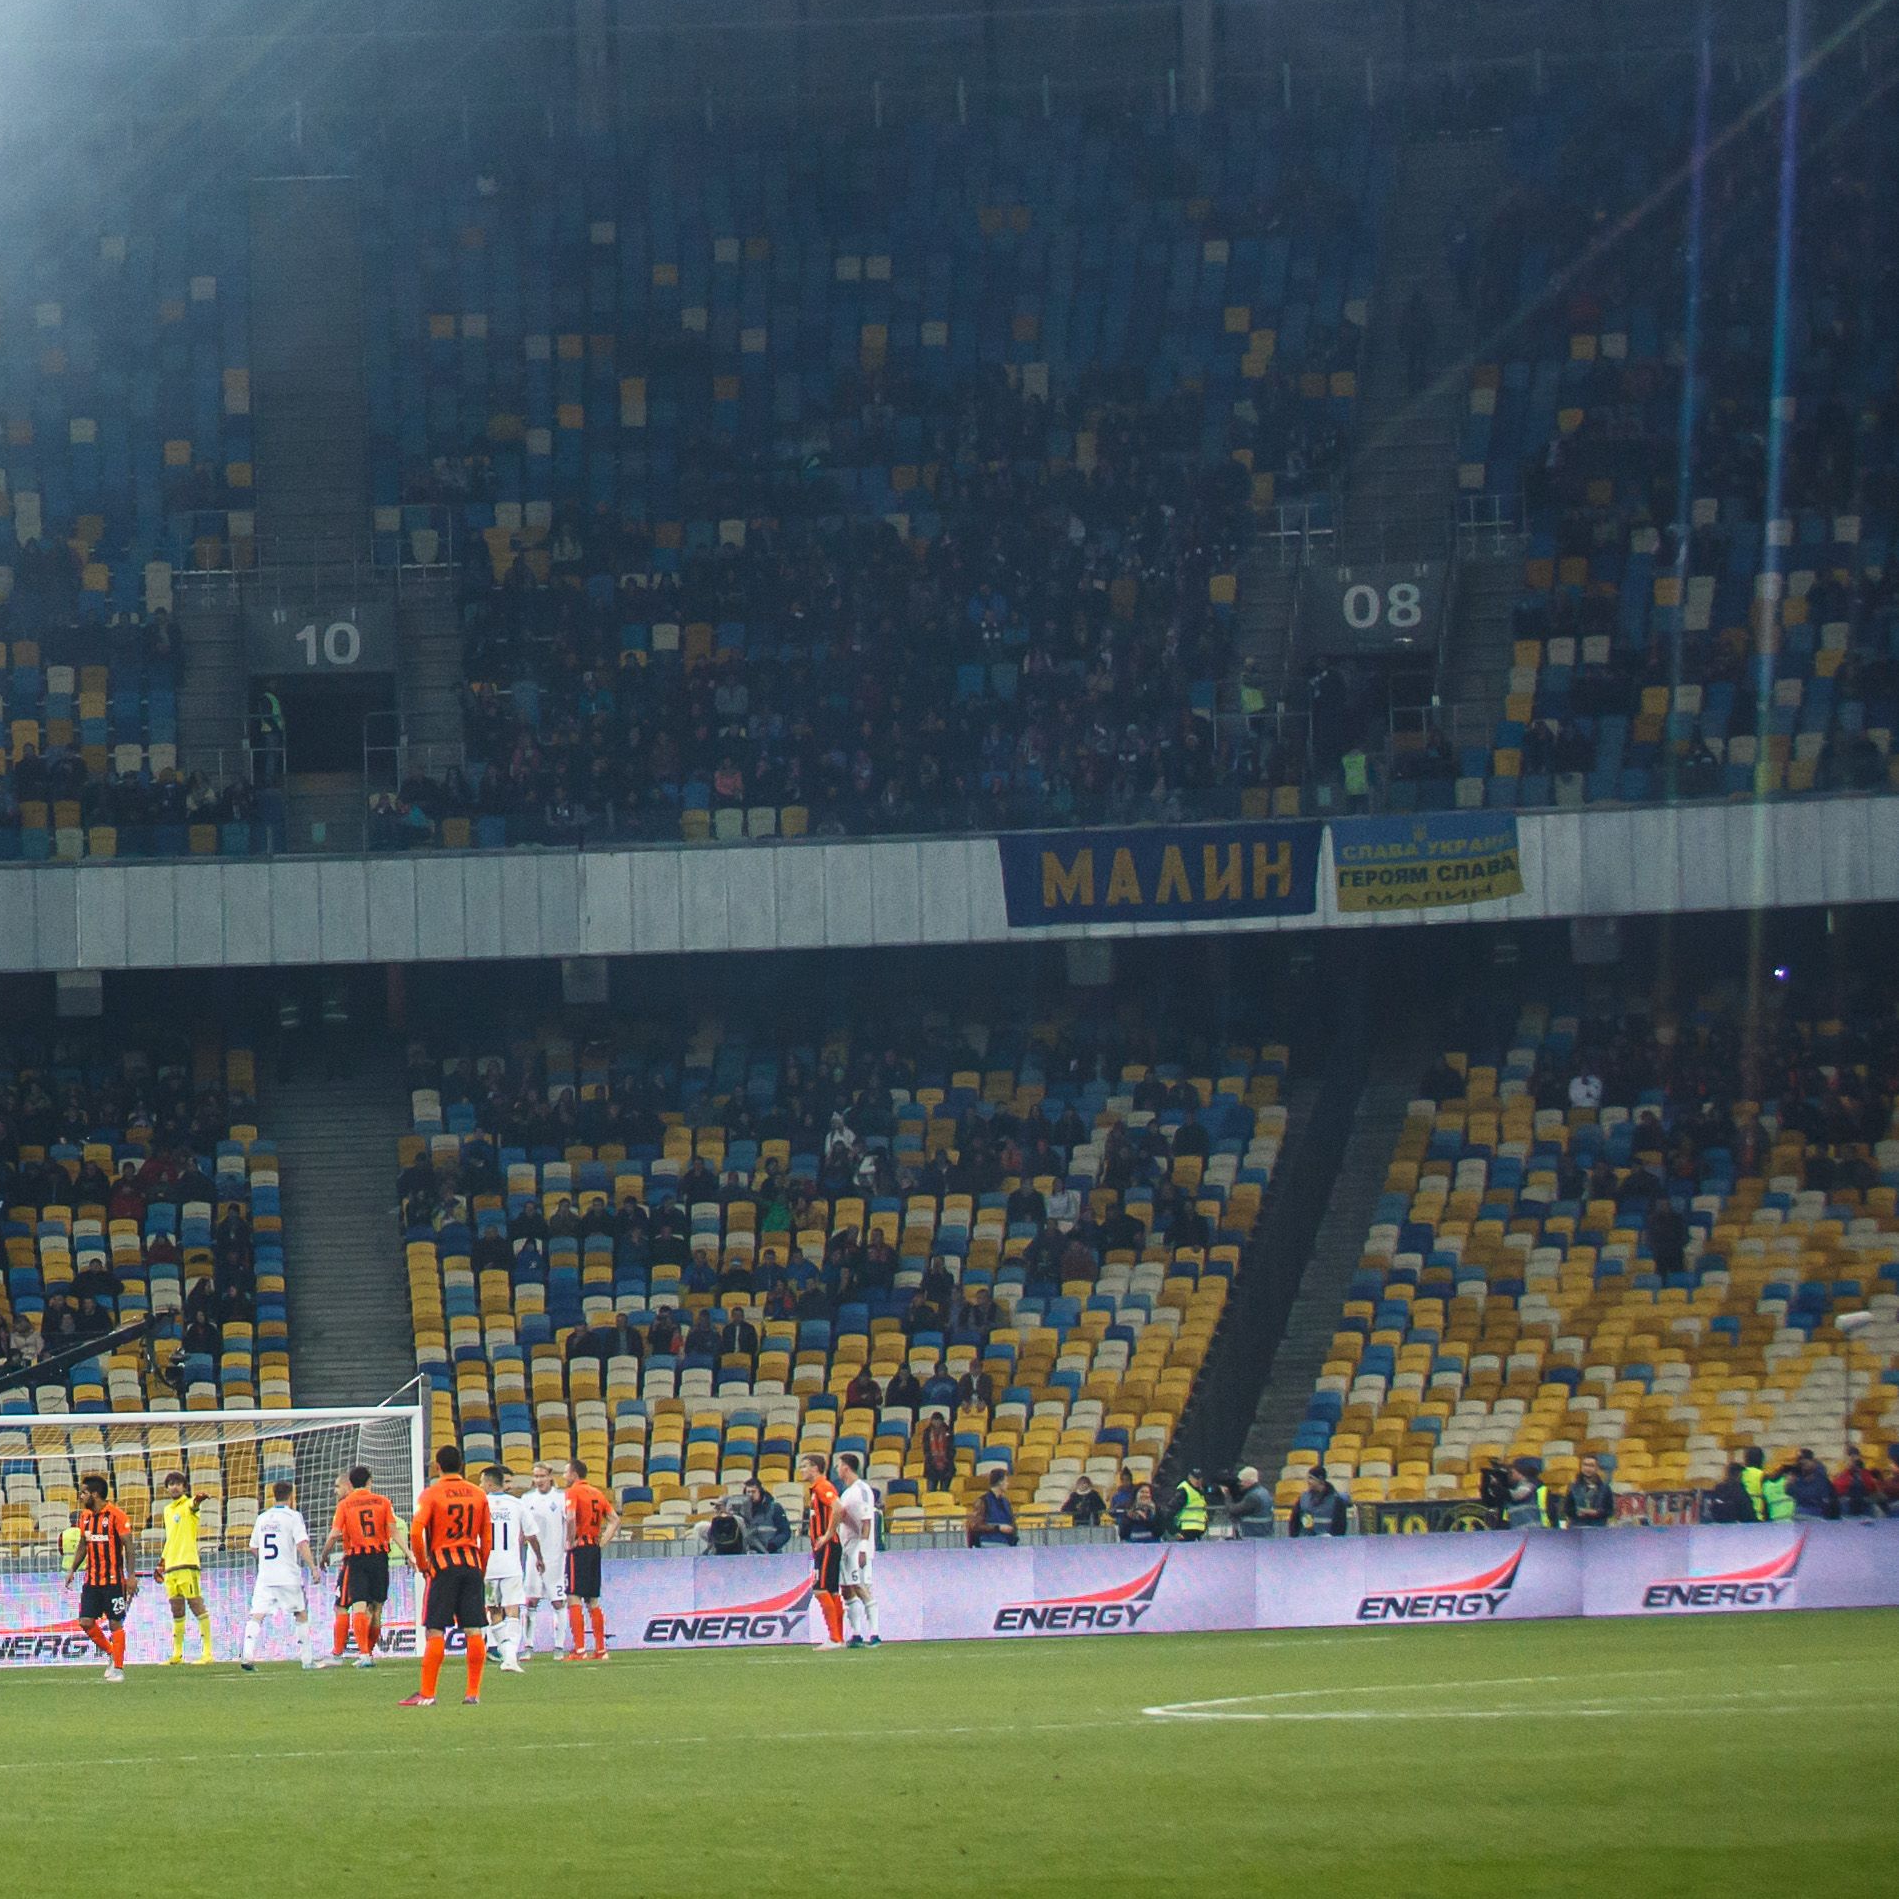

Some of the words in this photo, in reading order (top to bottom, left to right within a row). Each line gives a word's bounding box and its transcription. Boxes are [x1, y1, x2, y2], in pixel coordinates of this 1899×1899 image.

[1342, 582, 1422, 629] 08
[296, 621, 361, 666] 10
[1342, 843, 1419, 861] СЛАВА
[1041, 840, 1292, 908] МАЛИН
[1339, 866, 1429, 888] ГЕРОЯМ
[1436, 855, 1516, 883] СЛАВА
[359, 1509, 376, 1538] 6
[446, 1503, 474, 1539] 31
[264, 1533, 279, 1560] 5
[1356, 1591, 1510, 1620] ENERGY
[1643, 1581, 1793, 1609] ENERGY
[643, 1614, 806, 1643] ENERGY
[993, 1600, 1152, 1632] ENERGY
